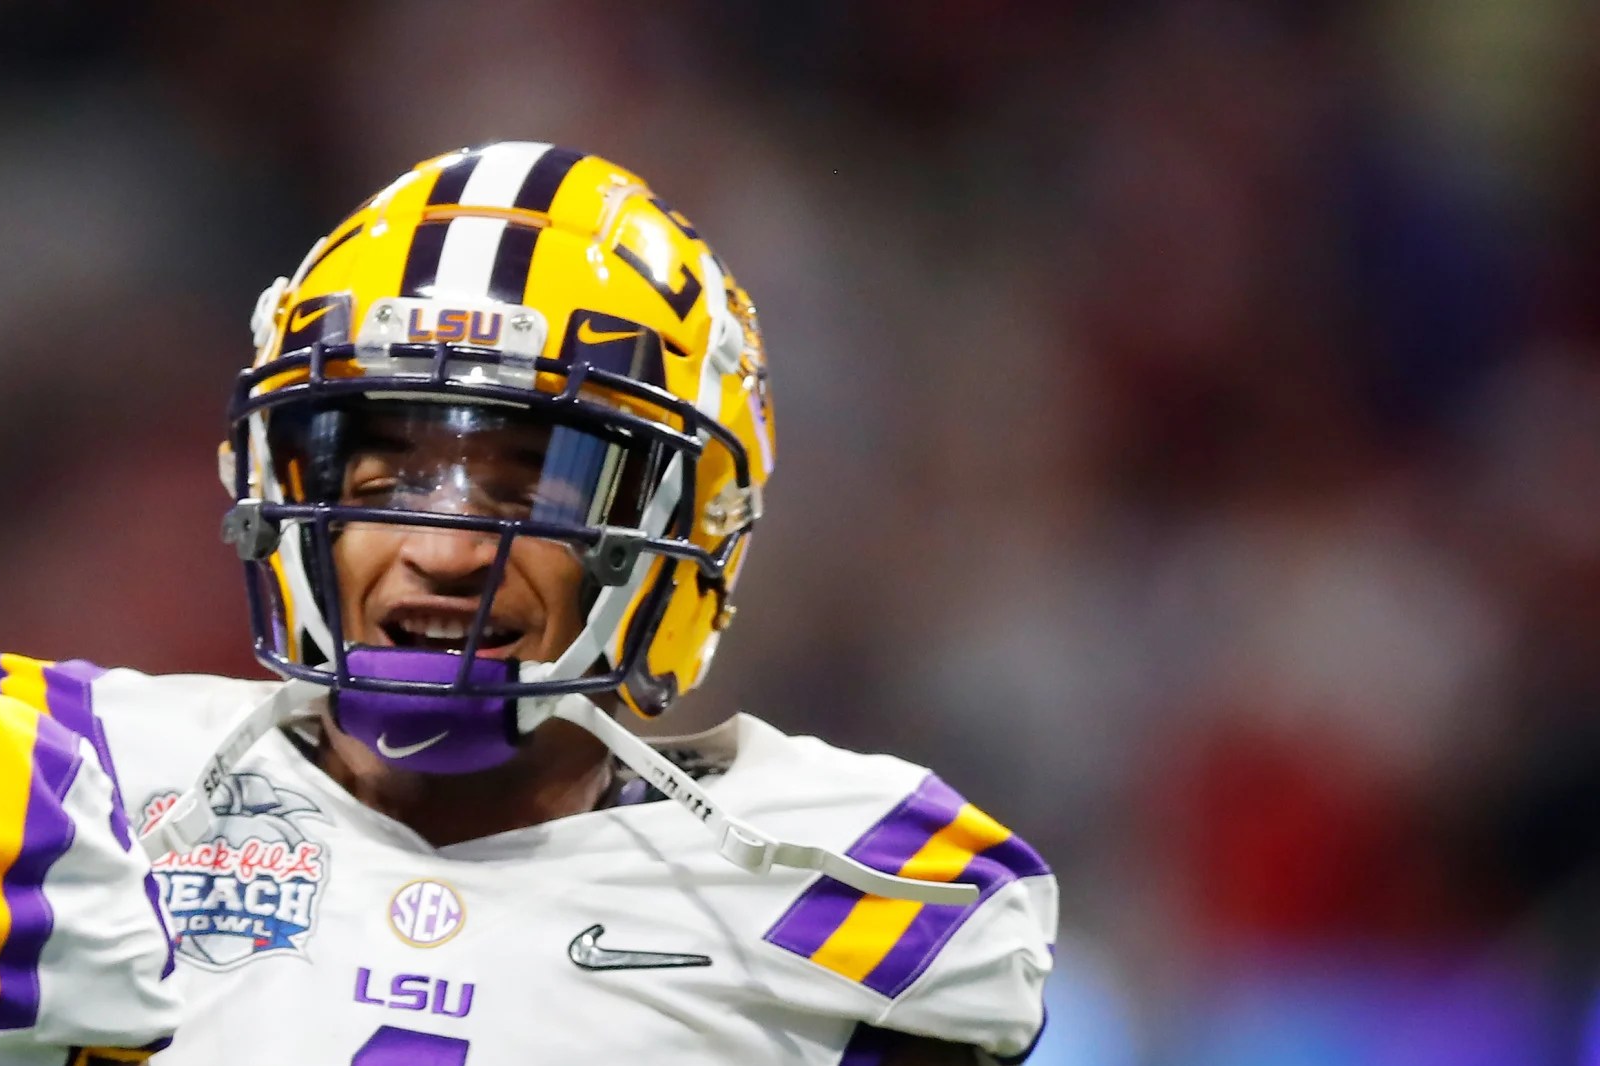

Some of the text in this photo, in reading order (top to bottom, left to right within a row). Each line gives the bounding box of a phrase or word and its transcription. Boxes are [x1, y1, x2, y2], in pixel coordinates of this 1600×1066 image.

[406, 307, 504, 347] LSU
[157, 872, 316, 928] EACH
[390, 880, 461, 943] SEC
[353, 967, 476, 1019] LSU
